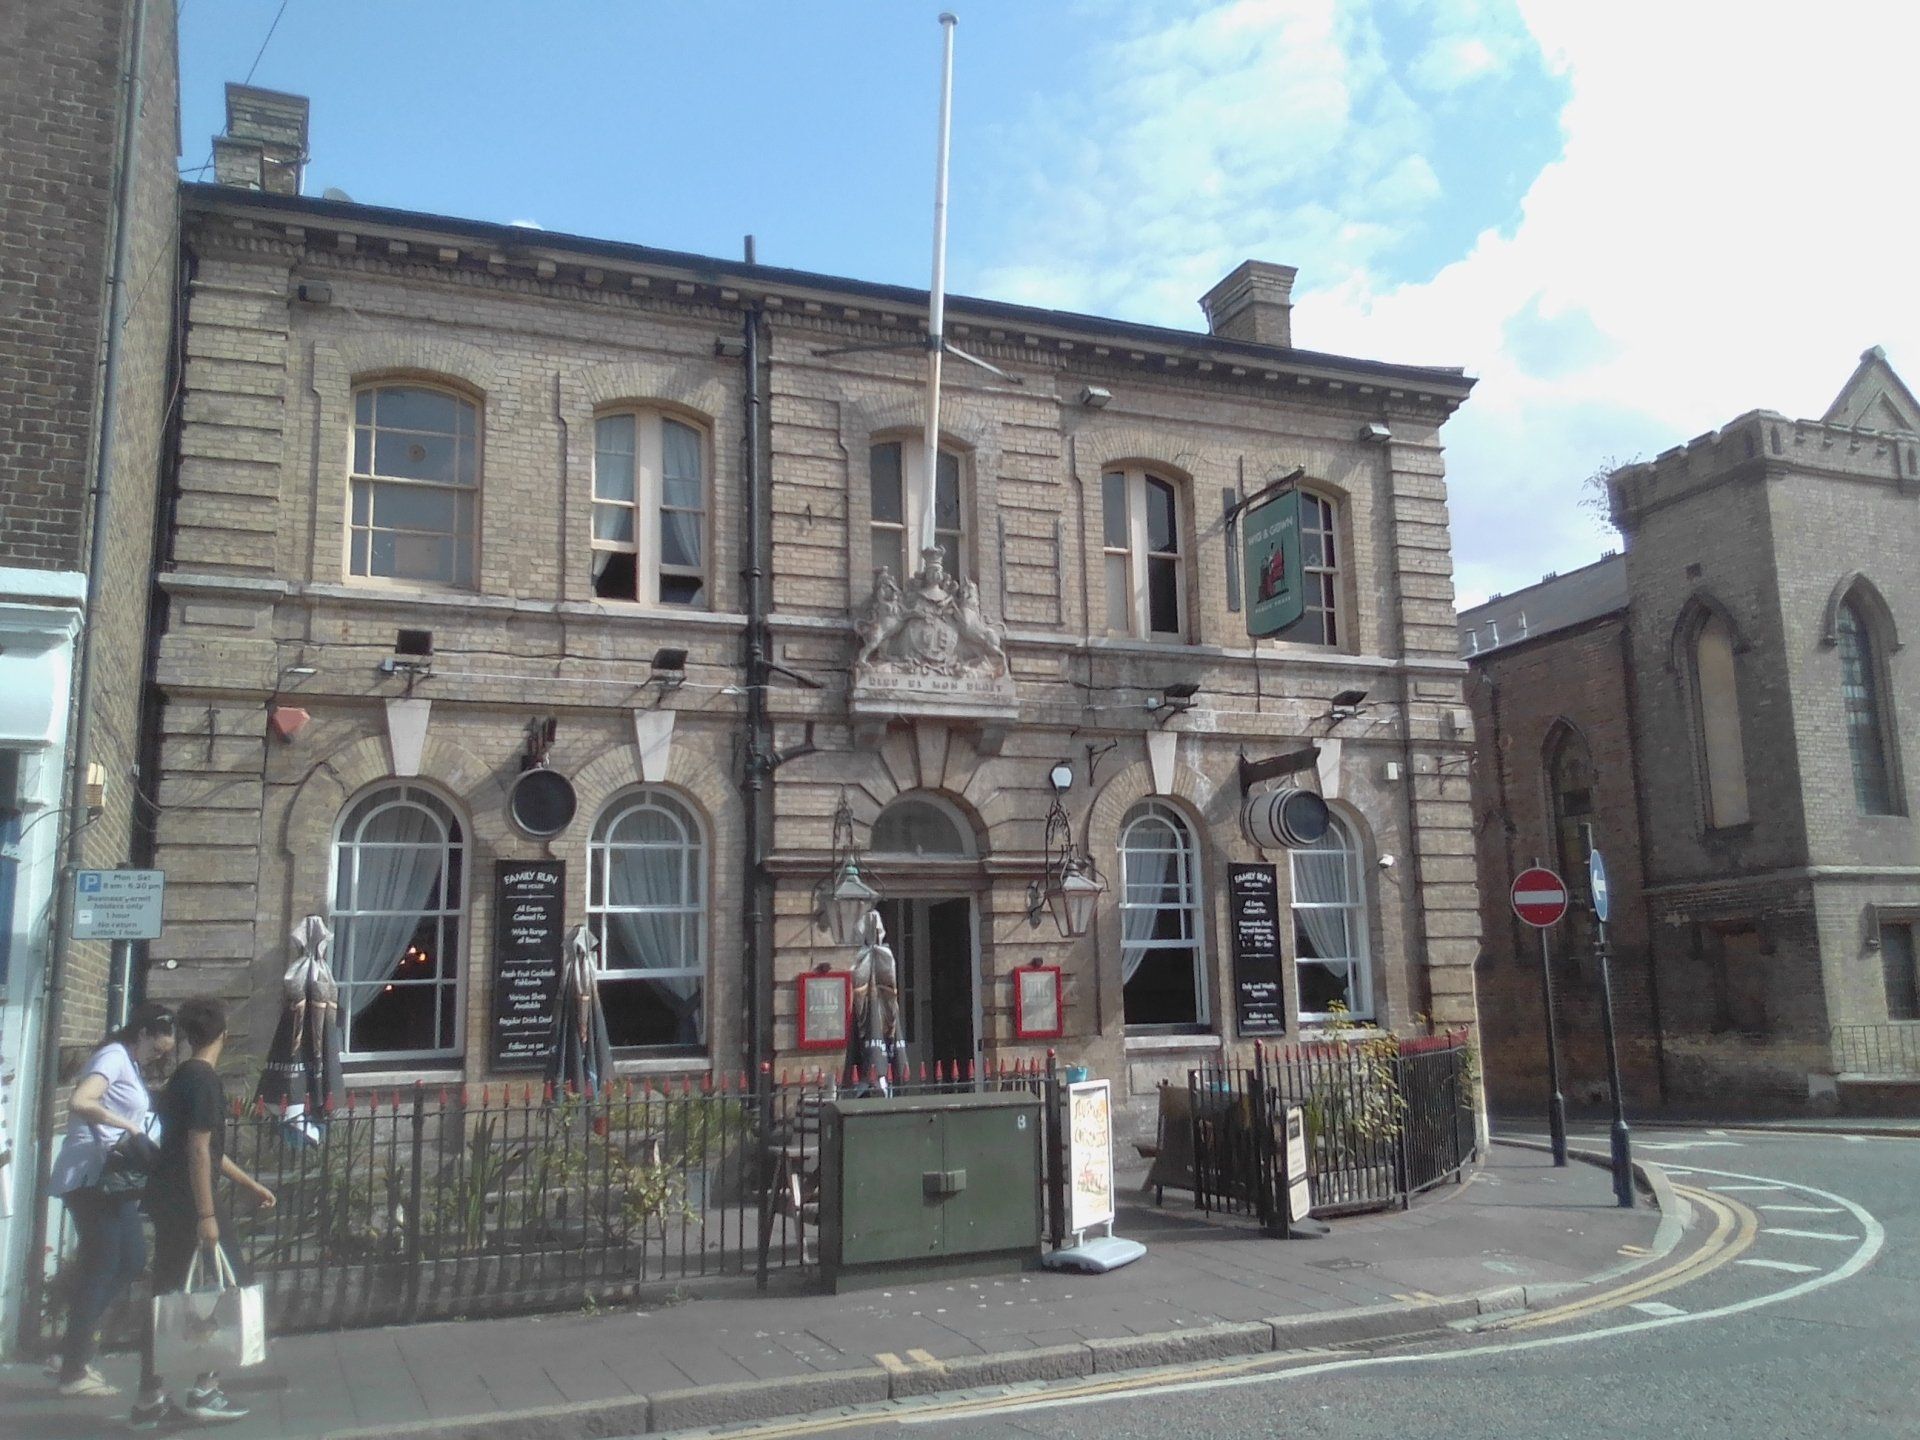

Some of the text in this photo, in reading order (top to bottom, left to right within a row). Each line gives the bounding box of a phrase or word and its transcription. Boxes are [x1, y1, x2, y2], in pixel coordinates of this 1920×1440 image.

[84, 875, 98, 890] P
[504, 871, 558, 885] FAMILY RUN
[1234, 872, 1256, 884] FAMILY
[516, 904, 525, 912] All
